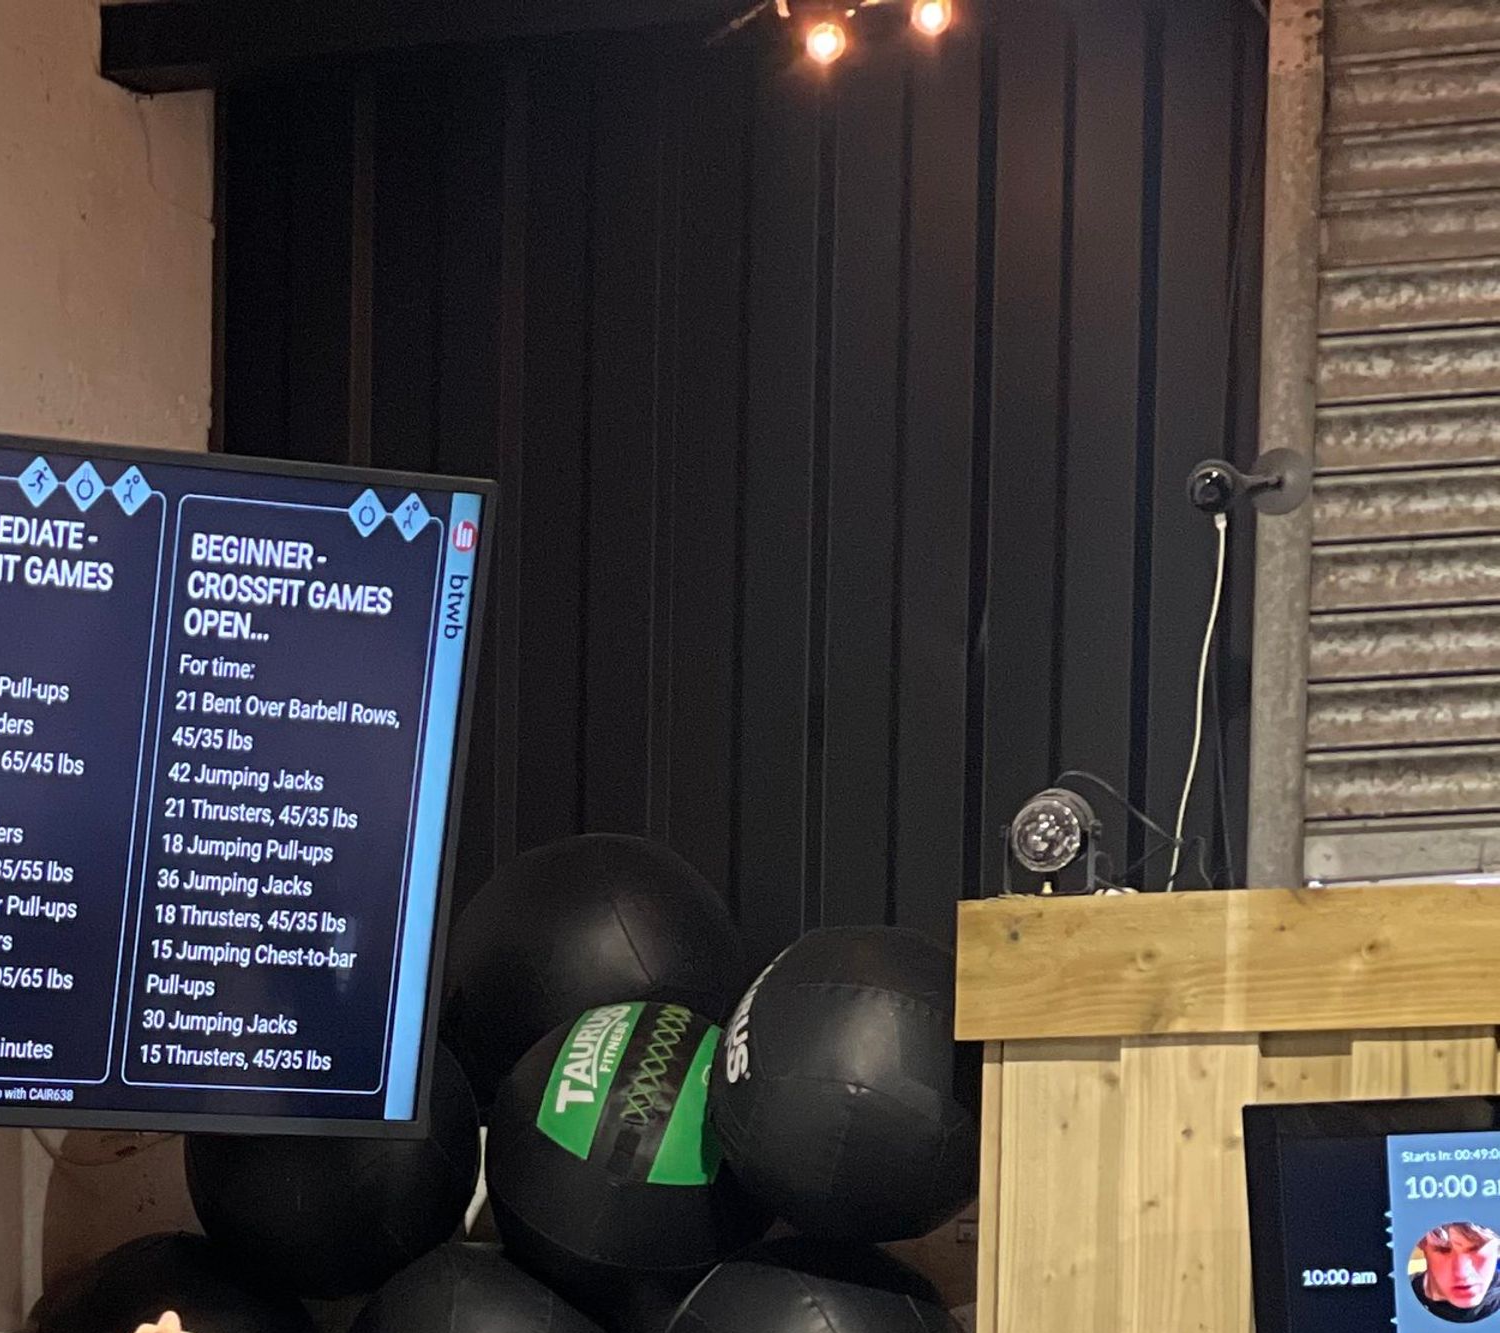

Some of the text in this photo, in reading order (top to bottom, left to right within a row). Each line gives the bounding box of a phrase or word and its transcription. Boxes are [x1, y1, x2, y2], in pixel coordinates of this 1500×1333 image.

[24, 556, 114, 591] GAMES
[187, 570, 393, 615] CROSSFIT GAMES
[444, 574, 469, 640] btwb
[179, 654, 255, 679] For time:
[175, 690, 399, 729] 21 Bent Over Barbell Rows,
[171, 726, 253, 751] 45/35 lbs
[0, 750, 54, 773] 65/45
[57, 752, 84, 775] lbs
[168, 762, 324, 792] 42 Jumping Jacks
[164, 797, 358, 829] 21 Thrusters, 45/35 lbs
[162, 833, 333, 866] 18 Jumping Pull-ups
[46, 860, 73, 883] lbs
[157, 868, 312, 898] 36 Jumping Jacks
[6, 895, 77, 922] Pull-ups
[155, 904, 346, 933] 18 Thrusters, 45/35 lbs
[151, 939, 357, 968] 15 Jumping Chest-to-bar
[46, 967, 73, 990] lbs
[146, 973, 215, 1000] Pull-ups
[142, 1009, 297, 1037] 30 Jumping Jacks
[140, 1044, 332, 1070] 15 Thrusters, 45/35 lbs
[555, 1004, 631, 1113] TAURUS
[4, 1087, 27, 1100] with
[1402, 1150, 1437, 1163] Starts
[1454, 1147, 1500, 1160] 00:49:0
[1405, 1174, 1500, 1199] 10:00 a
[1302, 1268, 1378, 1286] 10:00 am
